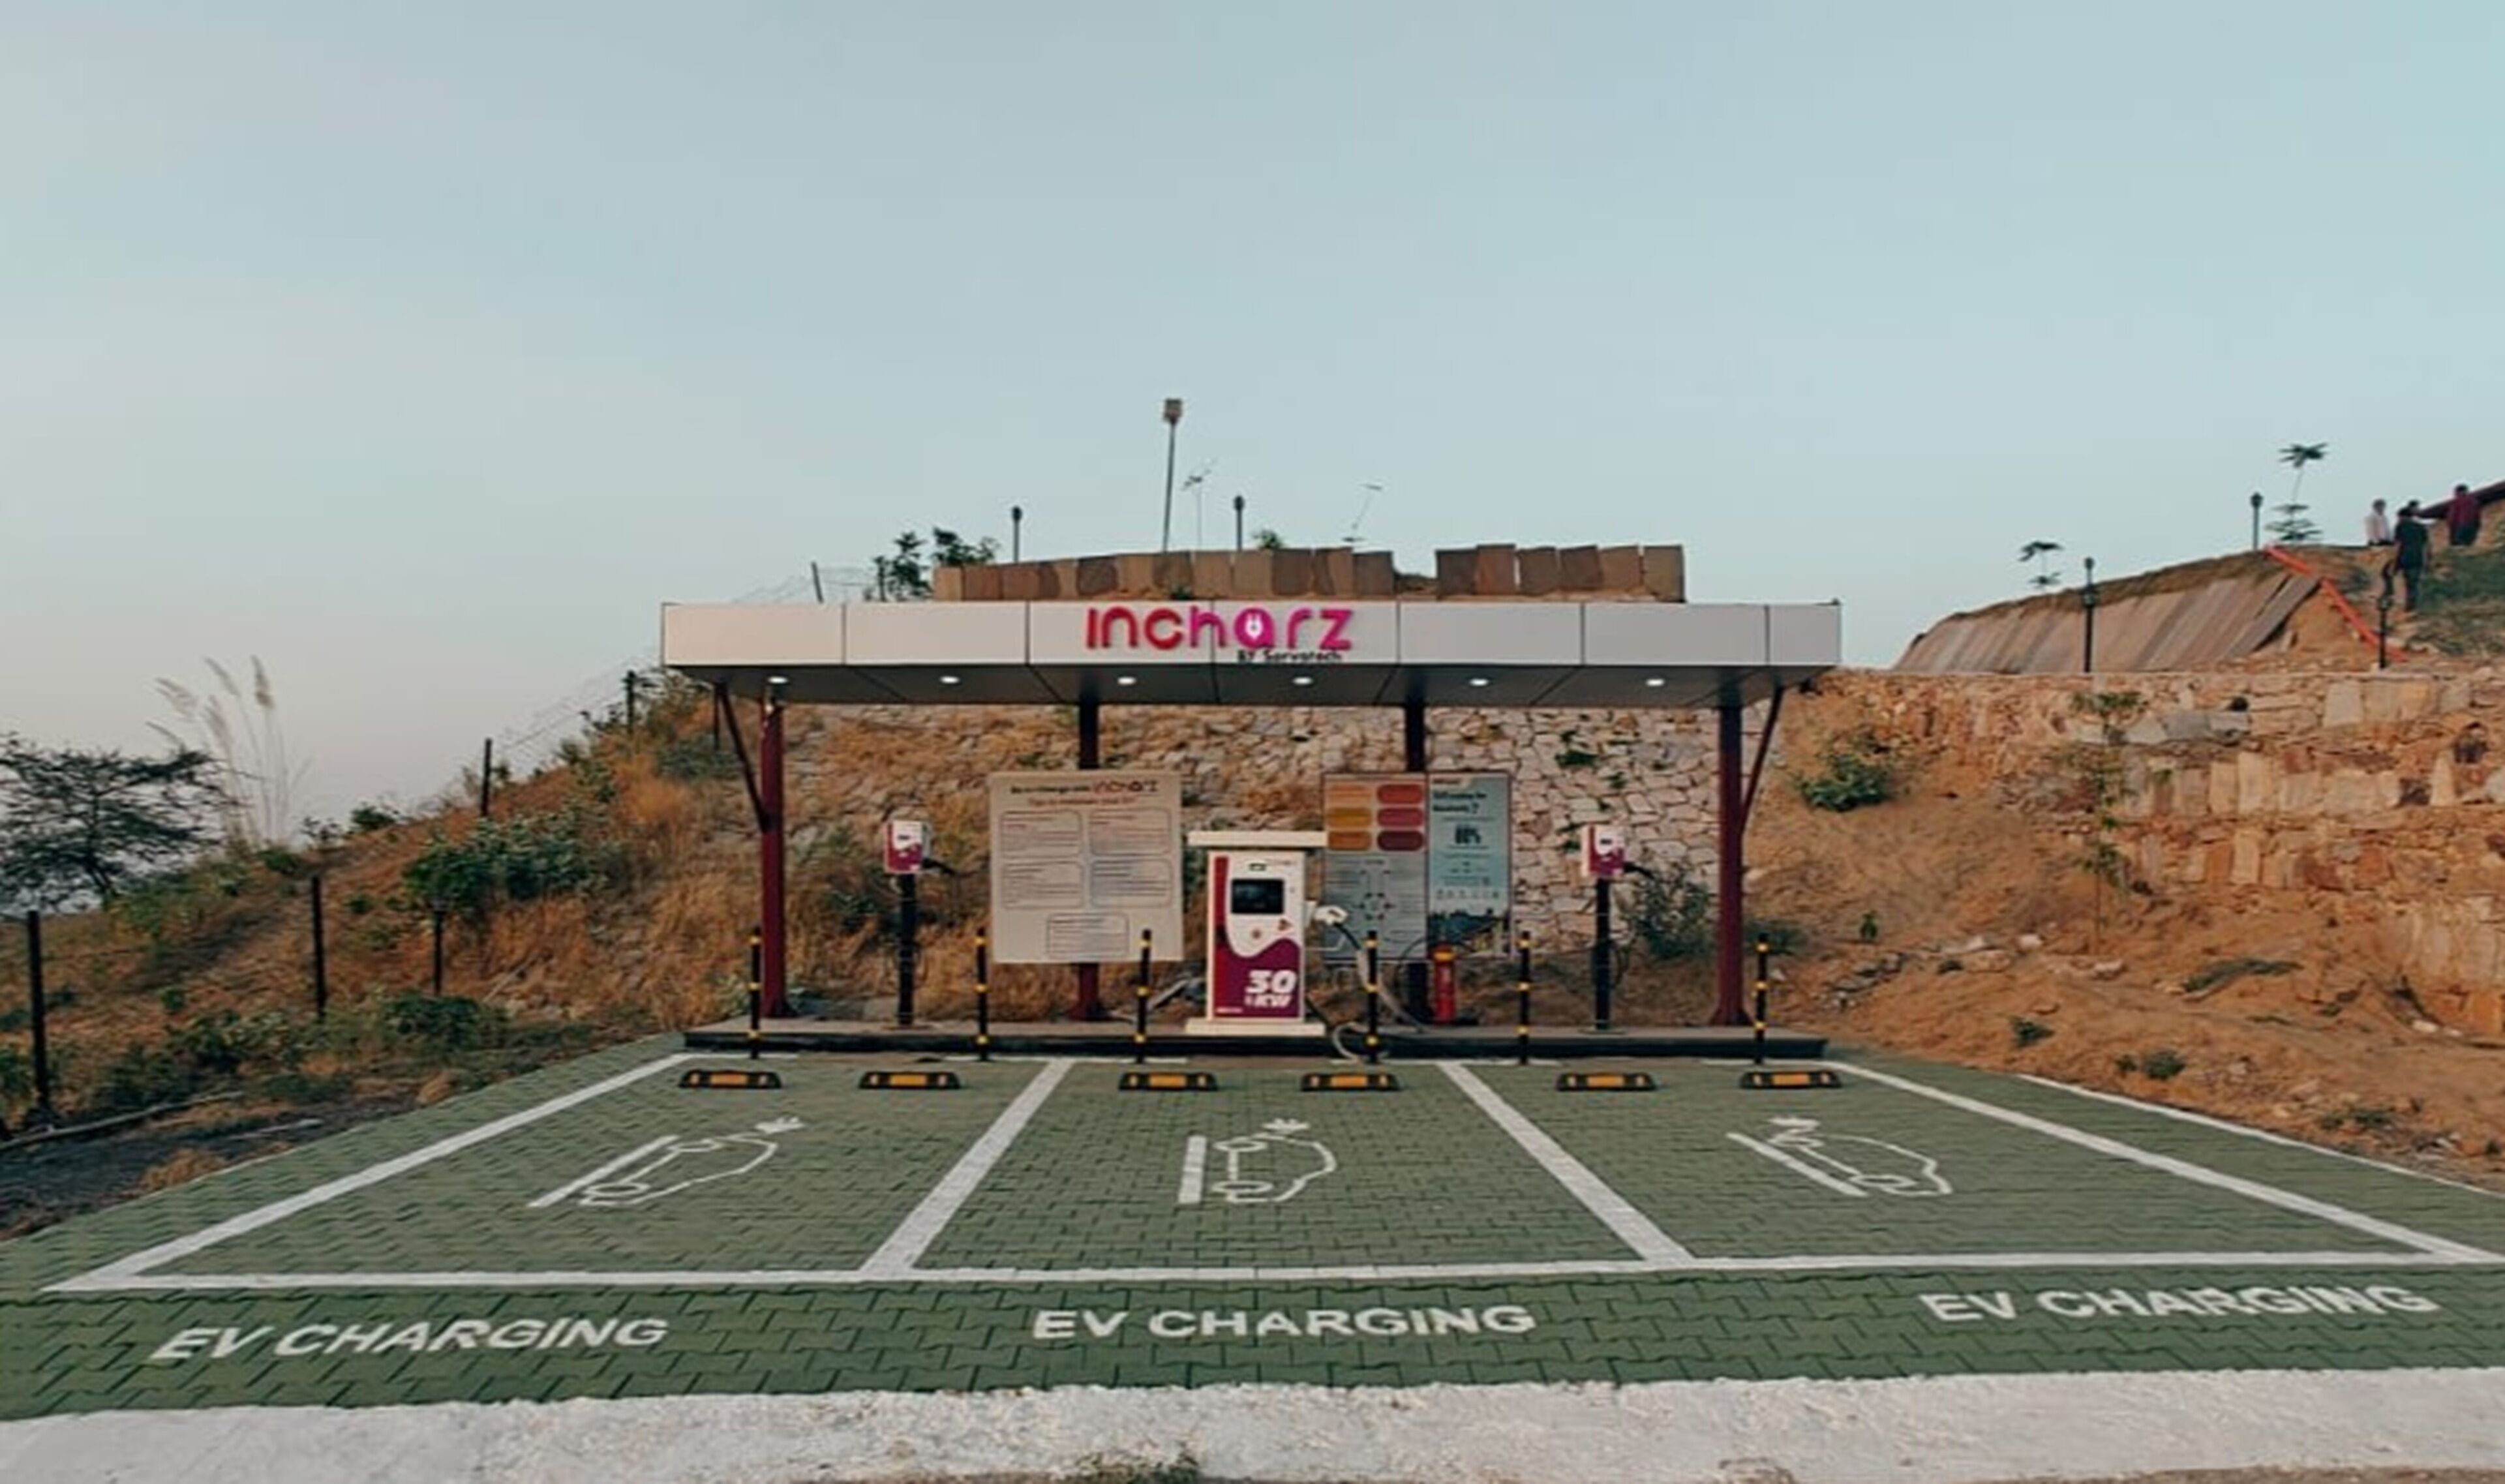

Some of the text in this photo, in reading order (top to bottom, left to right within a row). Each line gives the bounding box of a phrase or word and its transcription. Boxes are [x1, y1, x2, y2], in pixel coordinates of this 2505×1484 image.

[1245, 969, 1297, 993] 30
[1918, 1285, 2440, 1322] EV CHARGING
[149, 1318, 668, 1360] EV CHARGING
[1033, 1305, 1536, 1339] EV CHARGING
